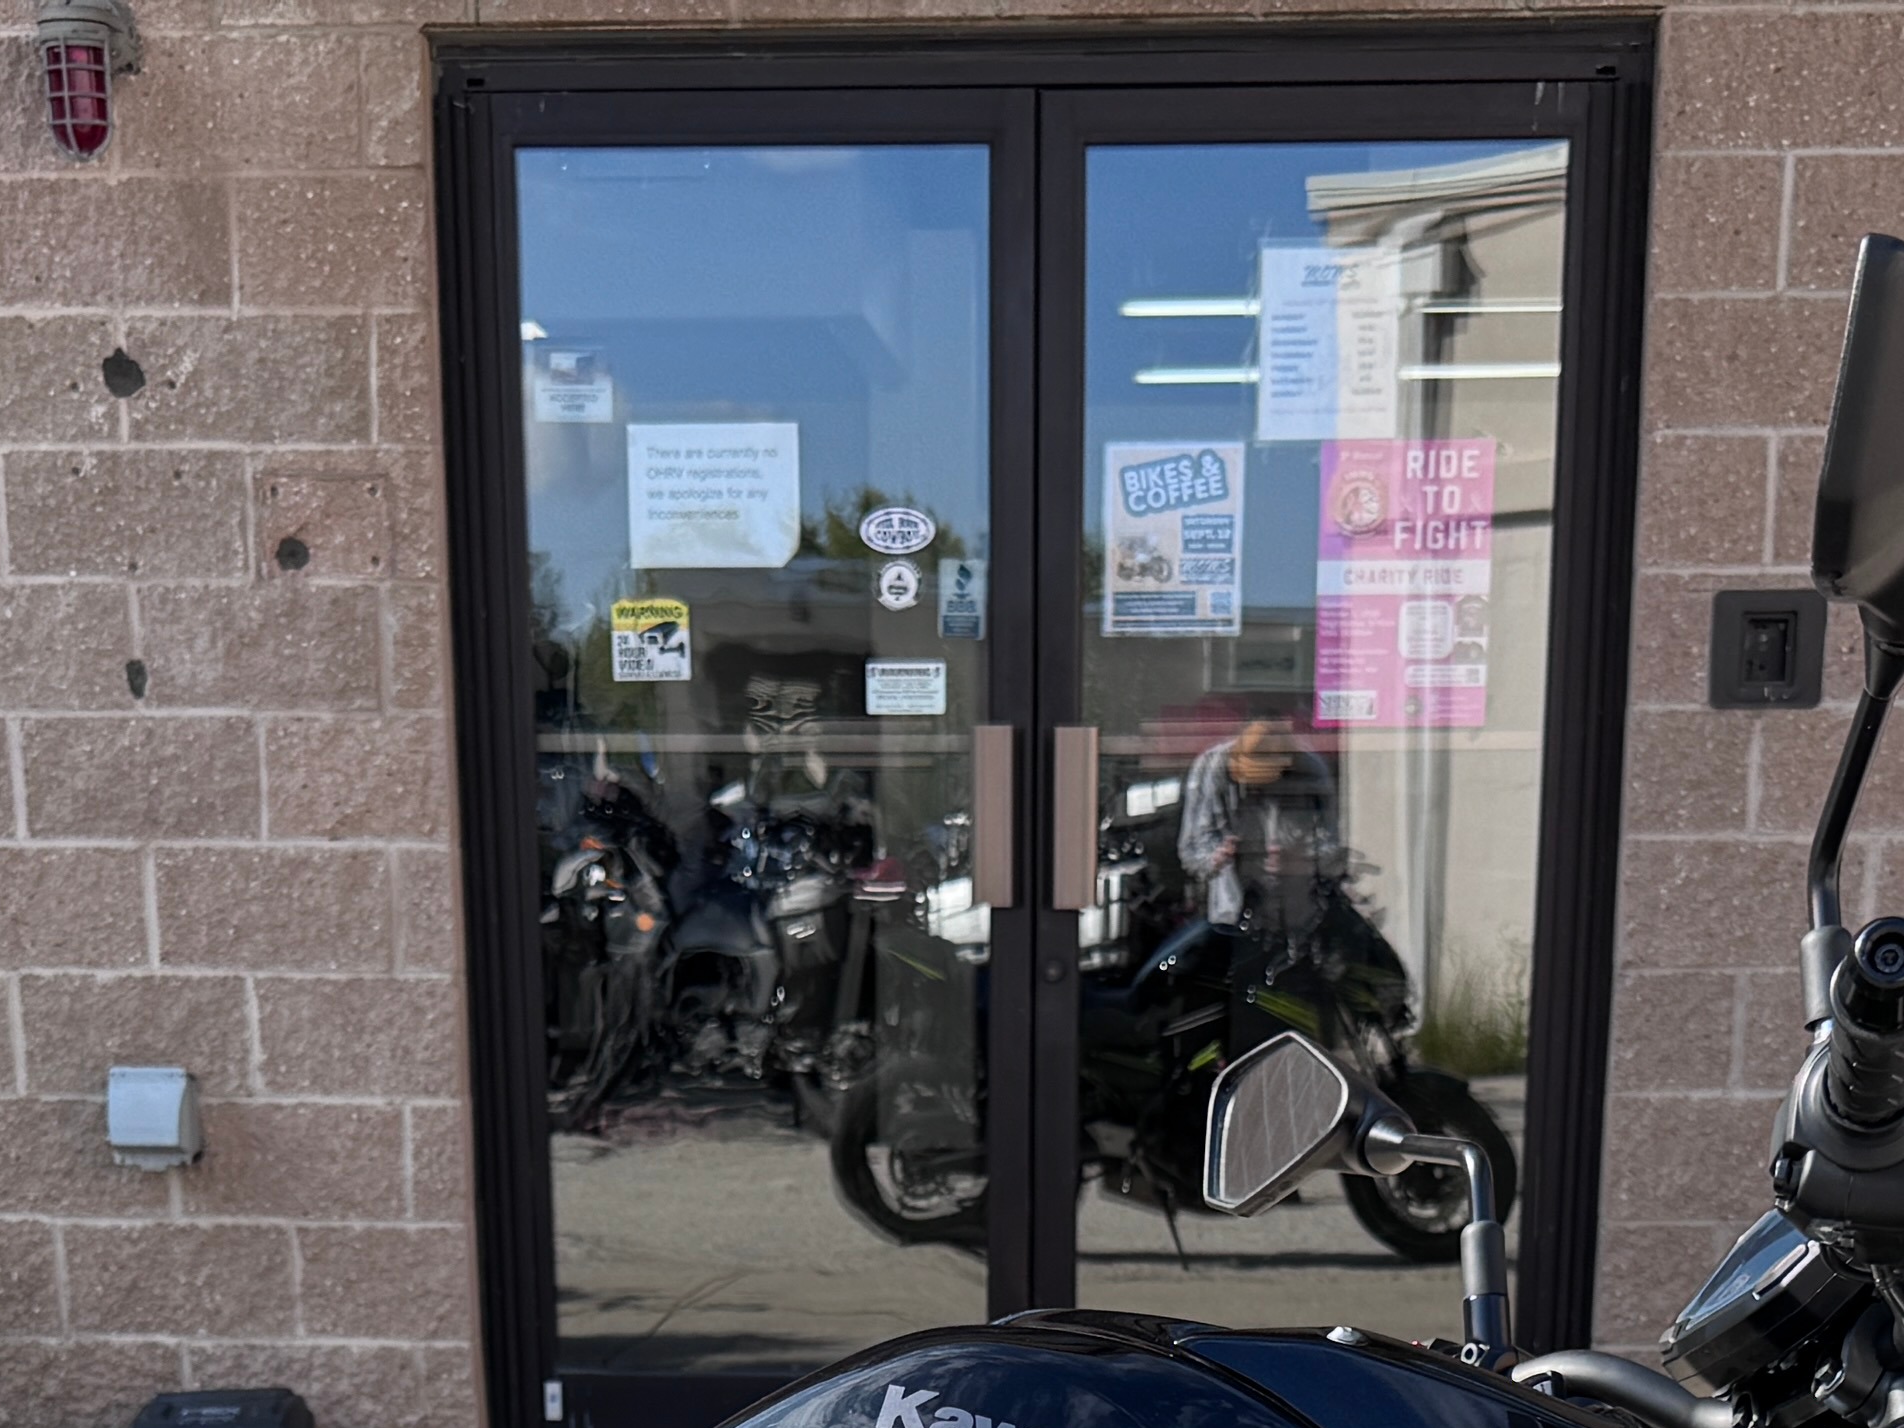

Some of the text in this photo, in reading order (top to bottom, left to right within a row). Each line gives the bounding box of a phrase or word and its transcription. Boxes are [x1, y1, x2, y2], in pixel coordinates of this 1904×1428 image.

[647, 447, 777, 460] There are currently no
[1406, 450, 1481, 479] RIDE
[1124, 455, 1220, 492] BIKES &
[668, 488, 724, 501] apologize
[727, 487, 744, 499] for
[747, 489, 768, 501] any
[1128, 476, 1224, 511] COFFEE
[1422, 485, 1461, 515] TO
[1394, 521, 1489, 550] FIGHT
[1343, 567, 1463, 585] CHARITY RIDE
[615, 605, 683, 619] WARNING
